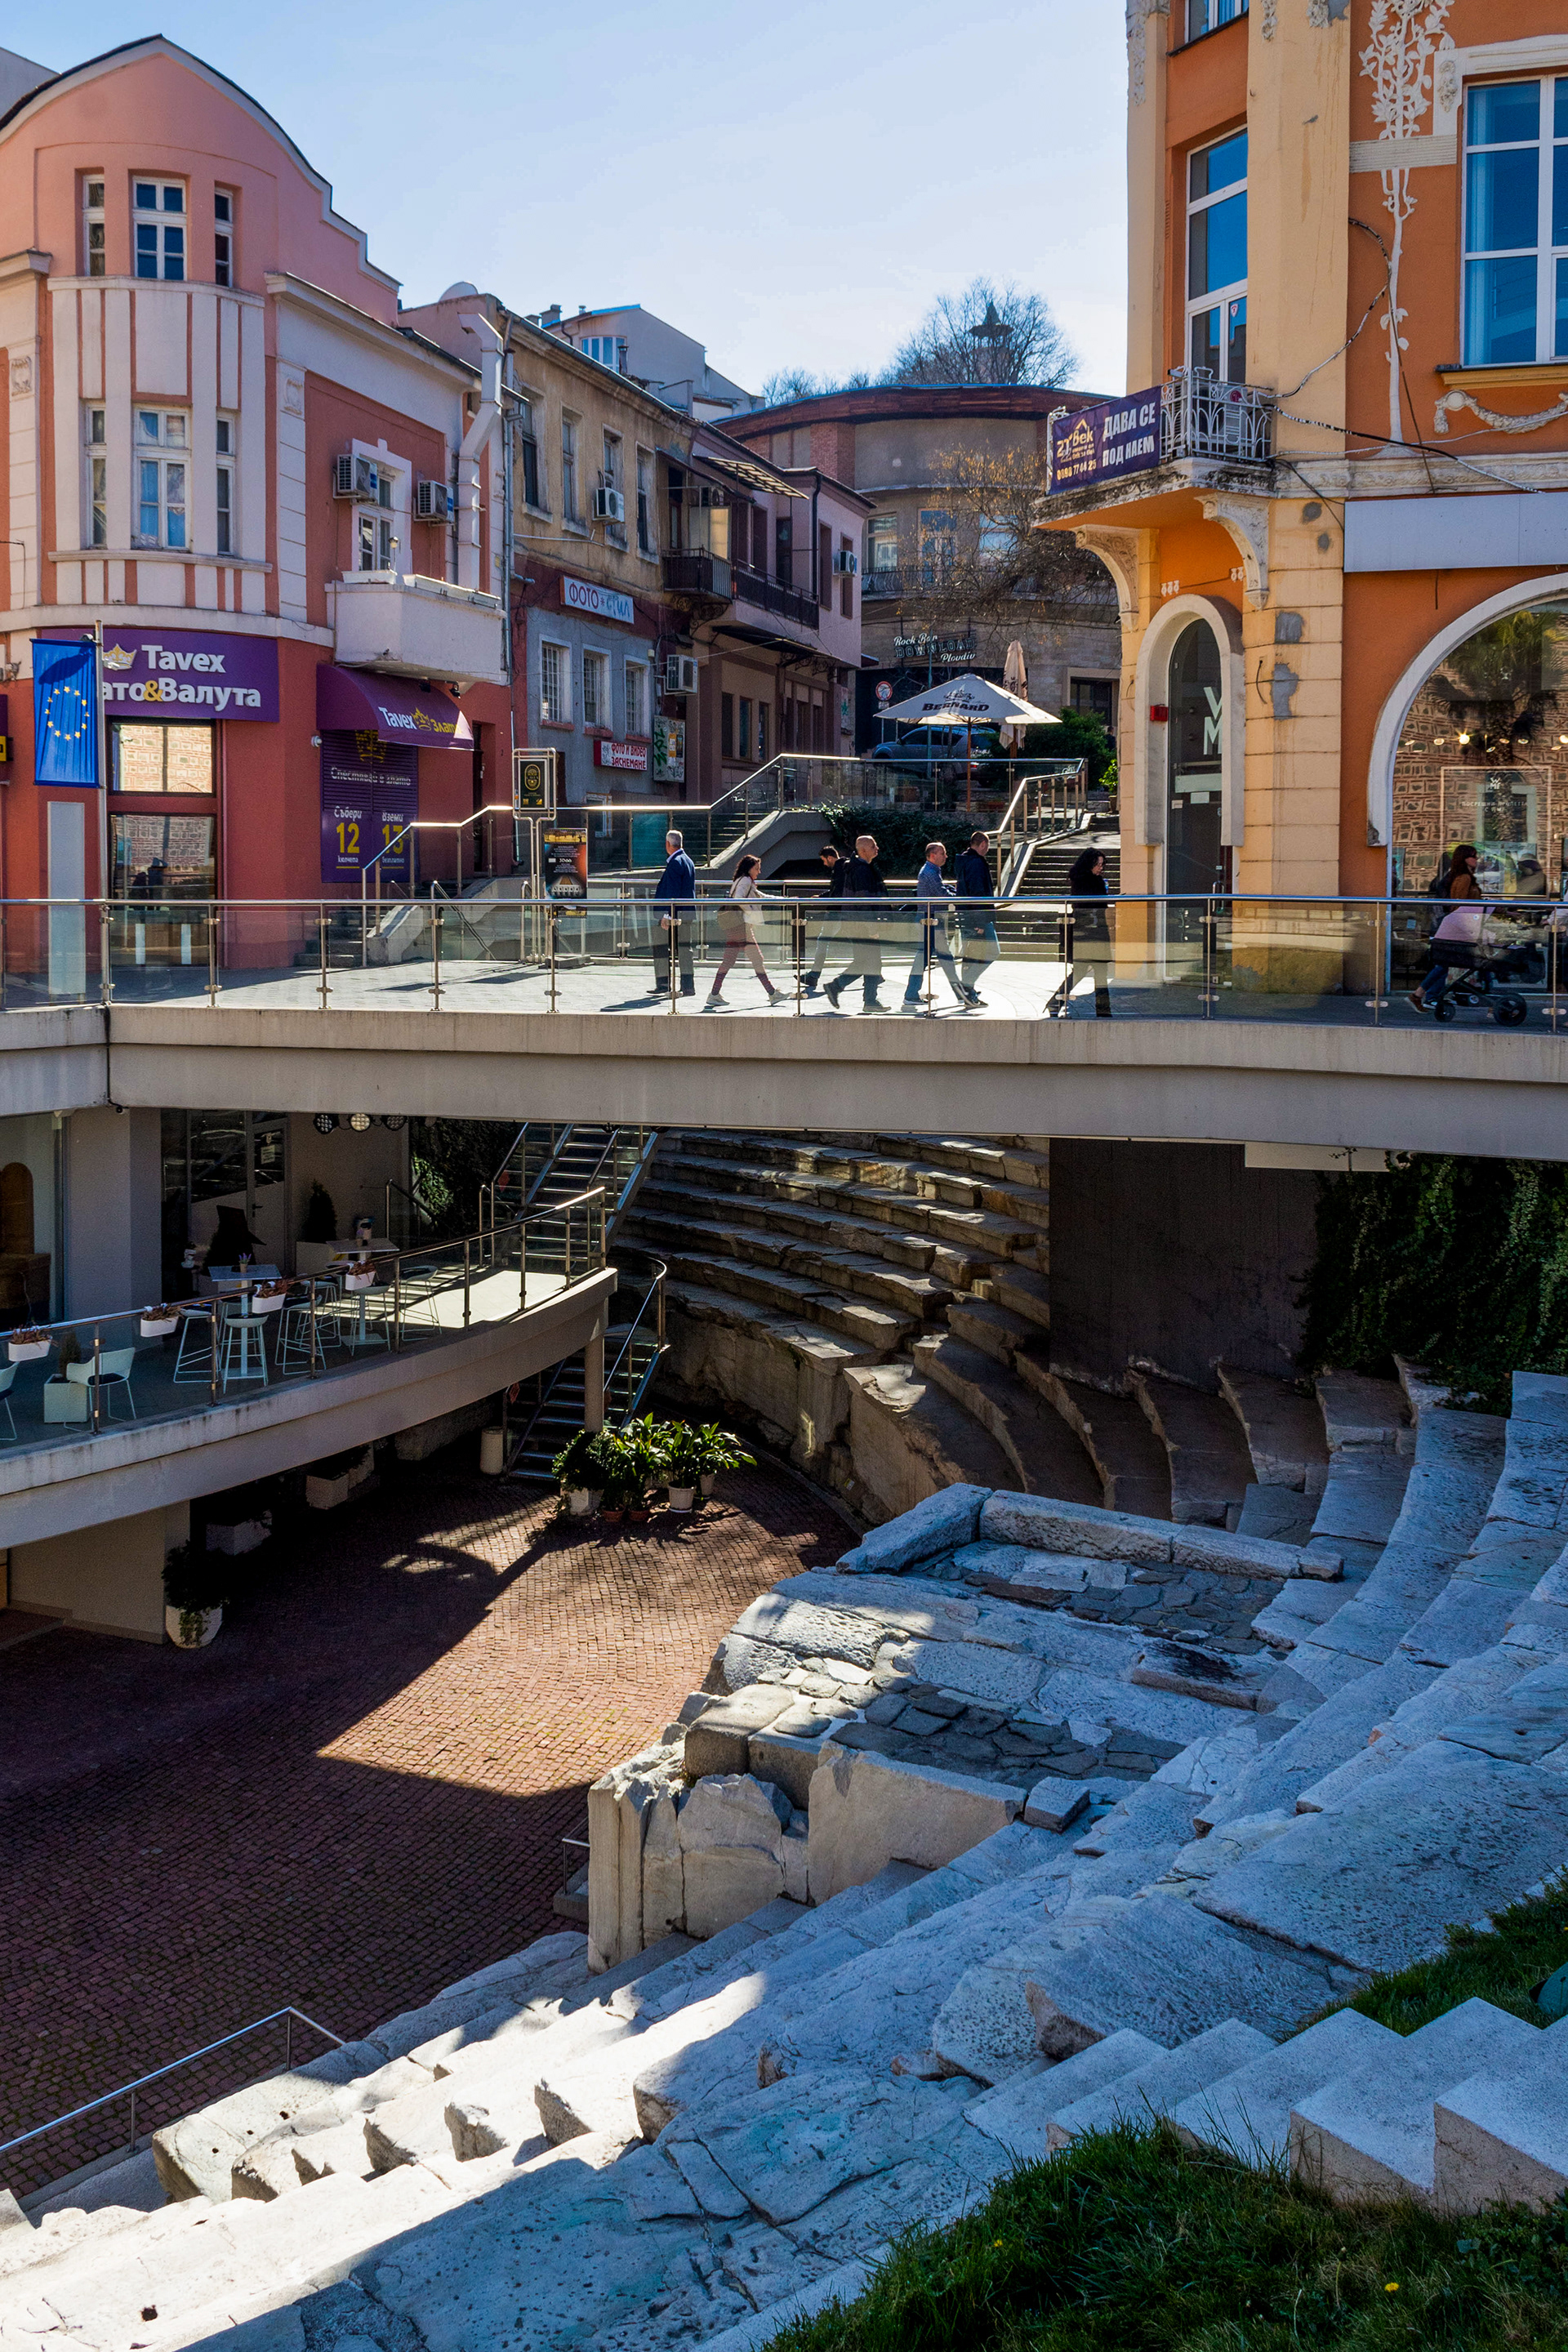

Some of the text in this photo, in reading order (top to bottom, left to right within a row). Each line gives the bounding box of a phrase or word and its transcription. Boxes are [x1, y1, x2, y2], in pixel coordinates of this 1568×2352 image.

[1103, 402, 1156, 442] ДАВА СЕ
[1102, 435, 1155, 467] ПОД НАЕМ
[569, 581, 599, 609] ФОТО
[894, 635, 915, 646] Rock
[895, 638, 977, 658] DOWNLOAD
[141, 644, 226, 673] Tavex
[941, 651, 976, 662] Plovdiv
[103, 677, 261, 711] ато&Валута
[922, 702, 990, 711] BERNARD
[378, 706, 417, 729] Tavex
[611, 756, 646, 769] ЗАСНЕМАНЕ
[336, 822, 403, 854] 12 13
